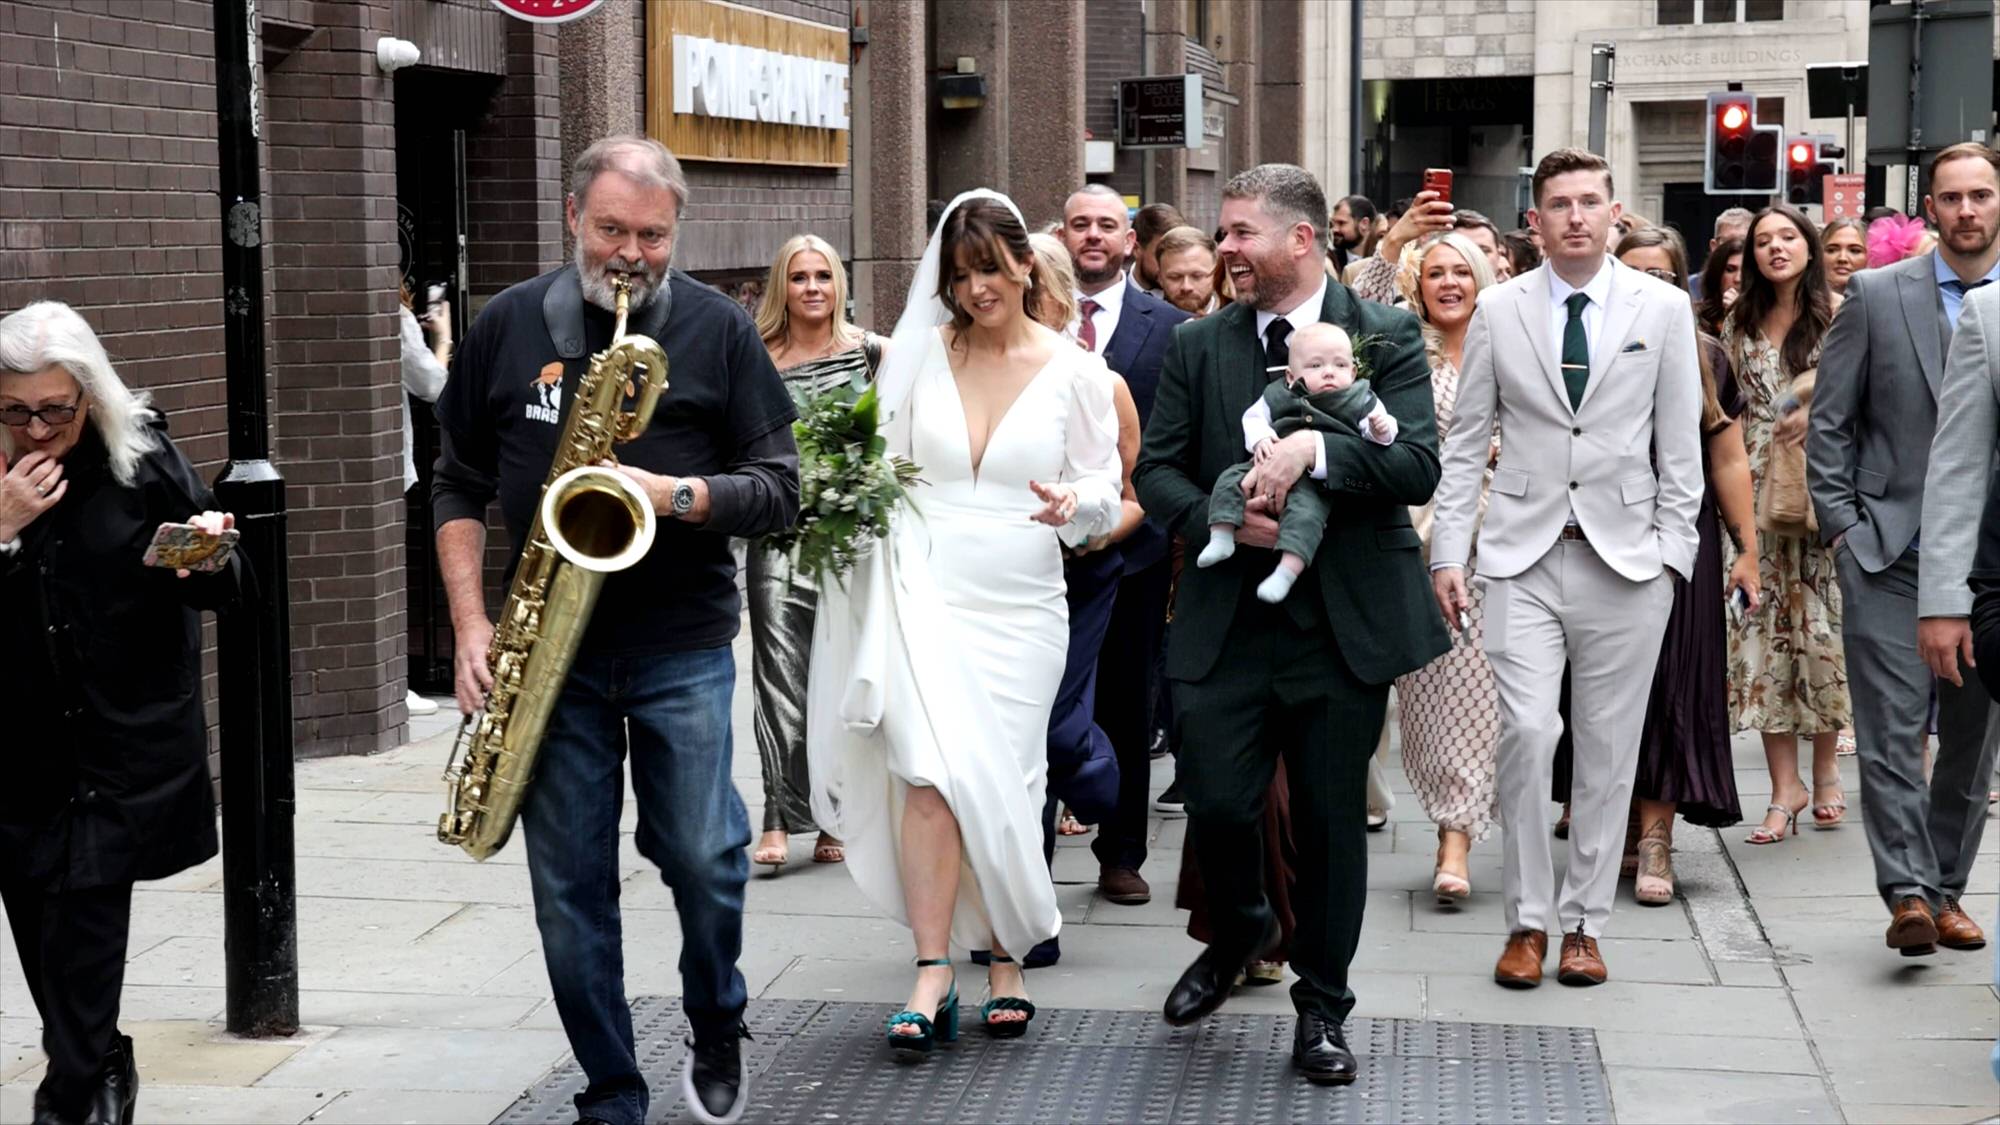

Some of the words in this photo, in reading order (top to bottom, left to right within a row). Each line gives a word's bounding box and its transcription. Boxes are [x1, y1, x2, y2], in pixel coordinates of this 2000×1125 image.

[1616, 53, 1700, 68] EXCHANGE
[1711, 50, 1801, 65] BUILDINGS
[673, 34, 849, 130] POMEGRANATE
[1143, 82, 1183, 95] GENTS
[1152, 95, 1183, 107] CODE
[525, 404, 559, 424] BRAS
